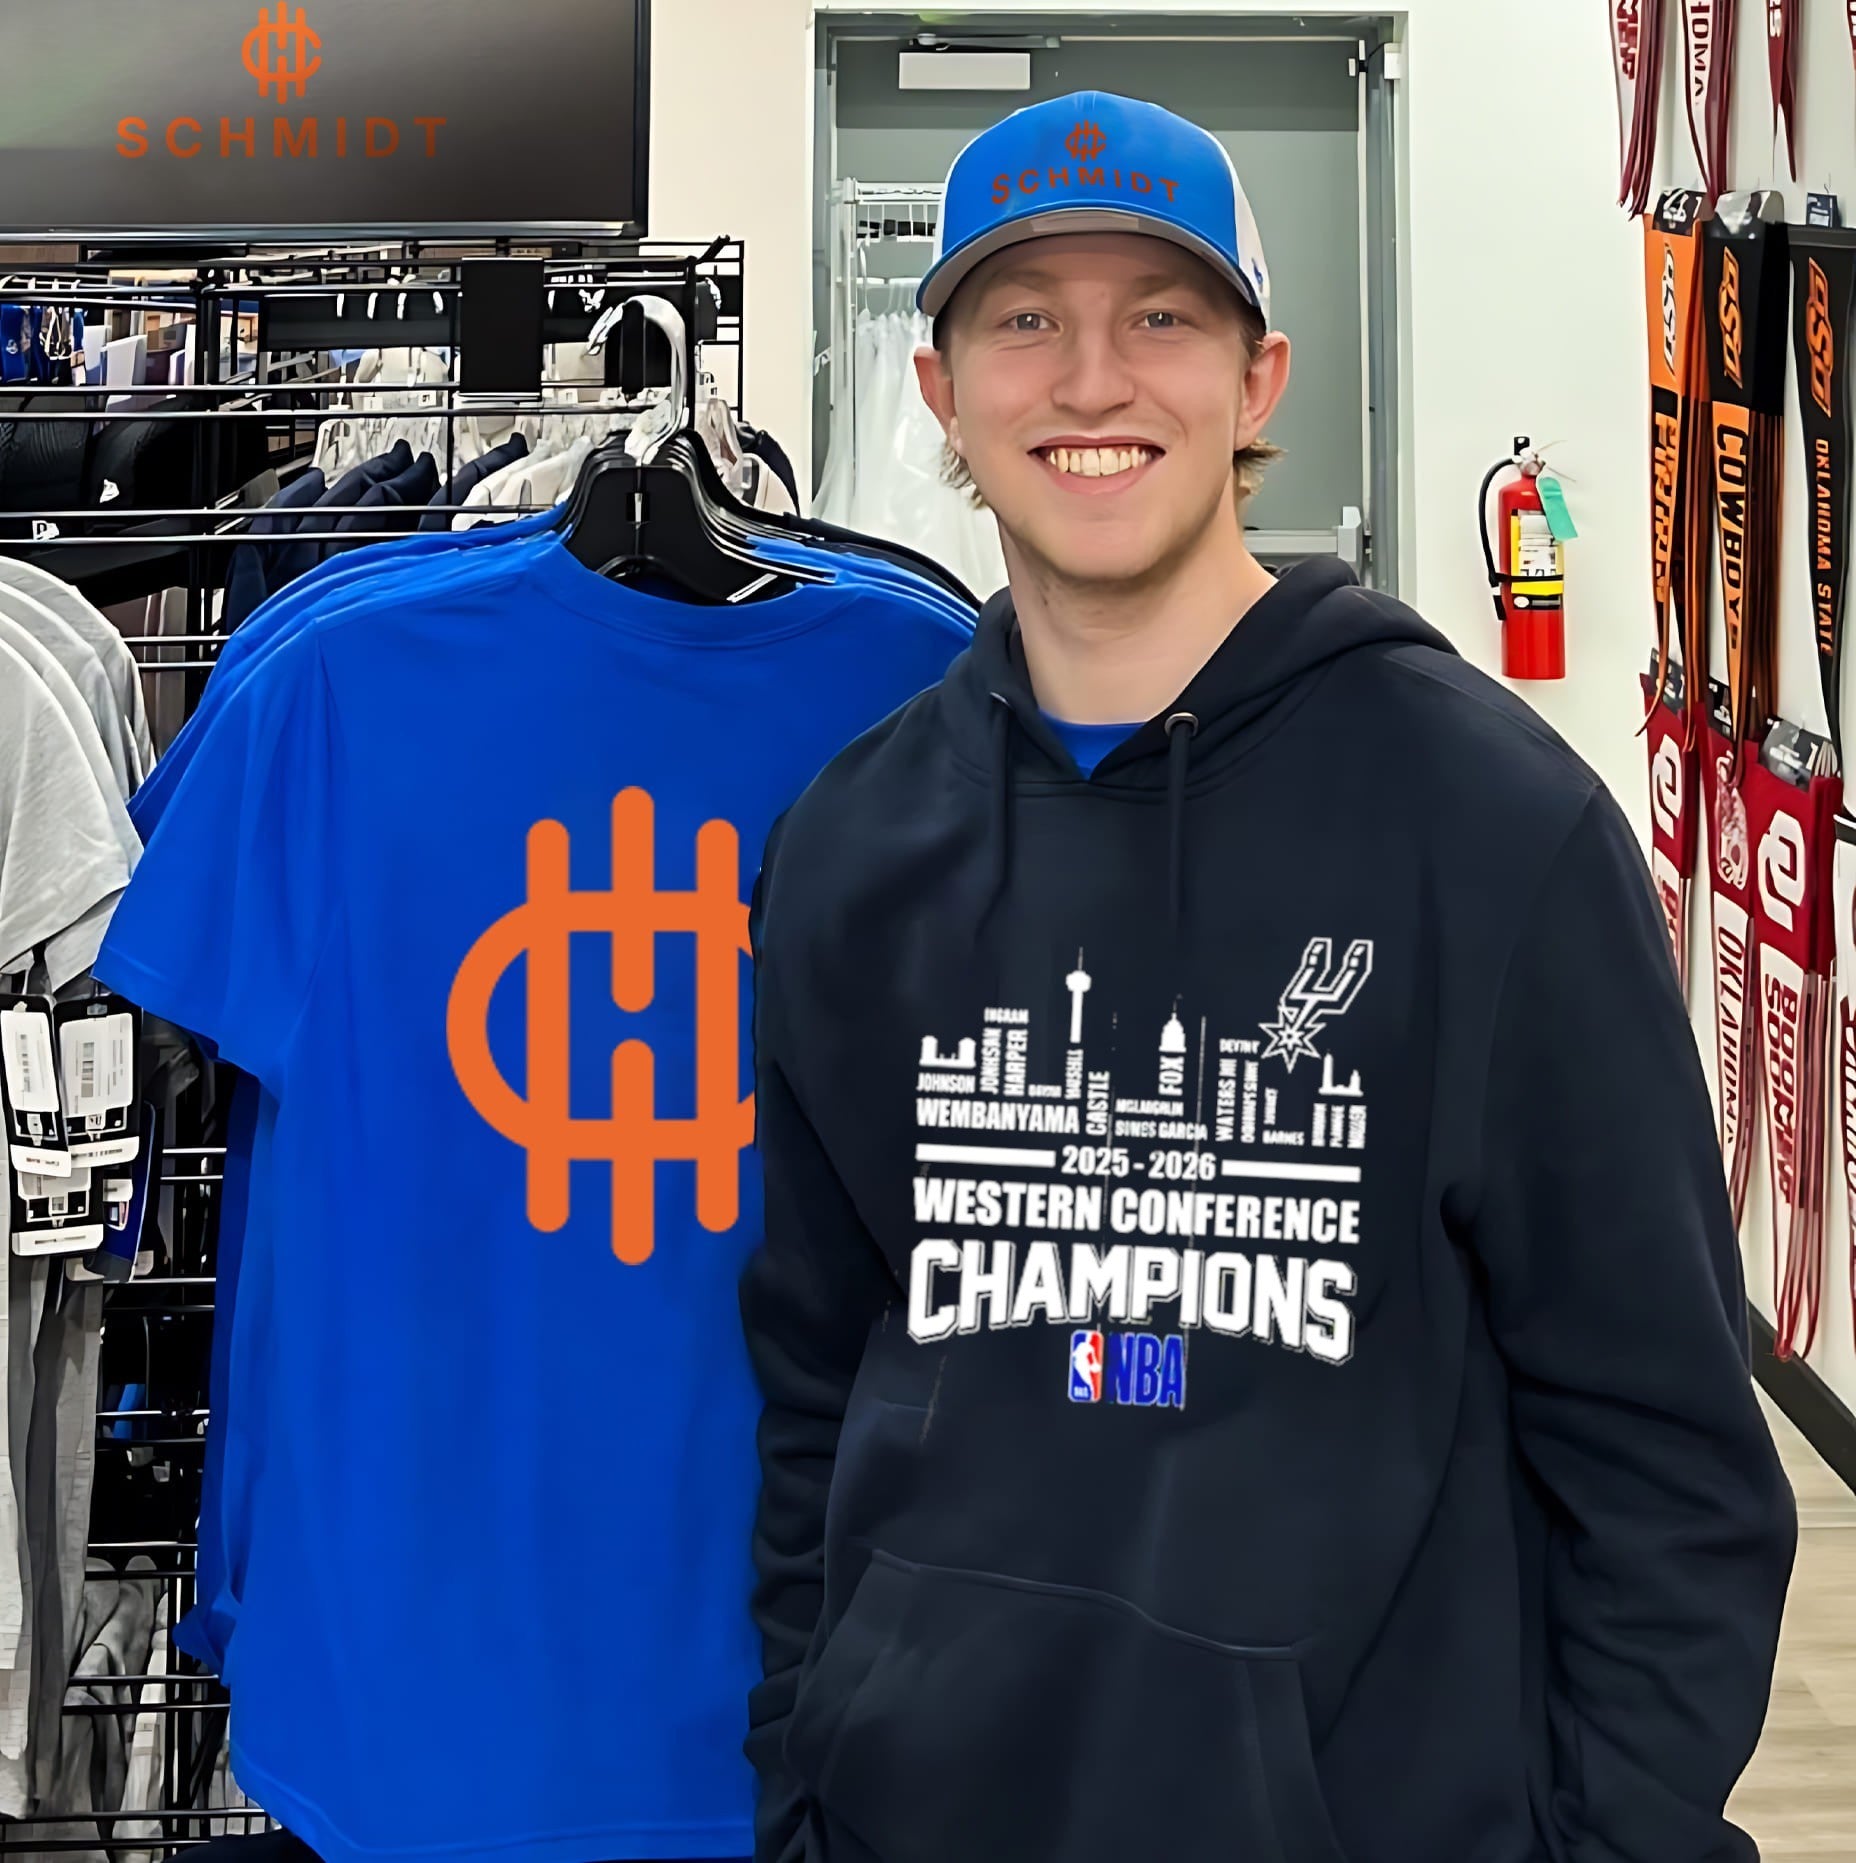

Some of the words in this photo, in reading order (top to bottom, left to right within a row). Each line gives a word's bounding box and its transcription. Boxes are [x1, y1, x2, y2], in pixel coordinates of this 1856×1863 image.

[115, 116, 448, 159] SCHMIDT
[991, 166, 1179, 205] SCHMIDT
[917, 1073, 975, 1093] JOHNSON
[1003, 1029, 1030, 1096] HARPER
[1159, 1056, 1184, 1095] FOX
[917, 1098, 1080, 1134] WEMBANYAMA
[1086, 1072, 1110, 1136] CASTLE
[1216, 1079, 1236, 1141] WATERS
[1158, 1122, 1207, 1141] GARCIA
[1062, 1146, 1128, 1176] 2025
[1149, 1151, 1215, 1180] 2026
[914, 1178, 1101, 1230] WESTERN
[1111, 1188, 1359, 1243] CONFERENCE
[907, 1238, 1359, 1367] CHAMPIONS
[1106, 1331, 1185, 1407] NBA
